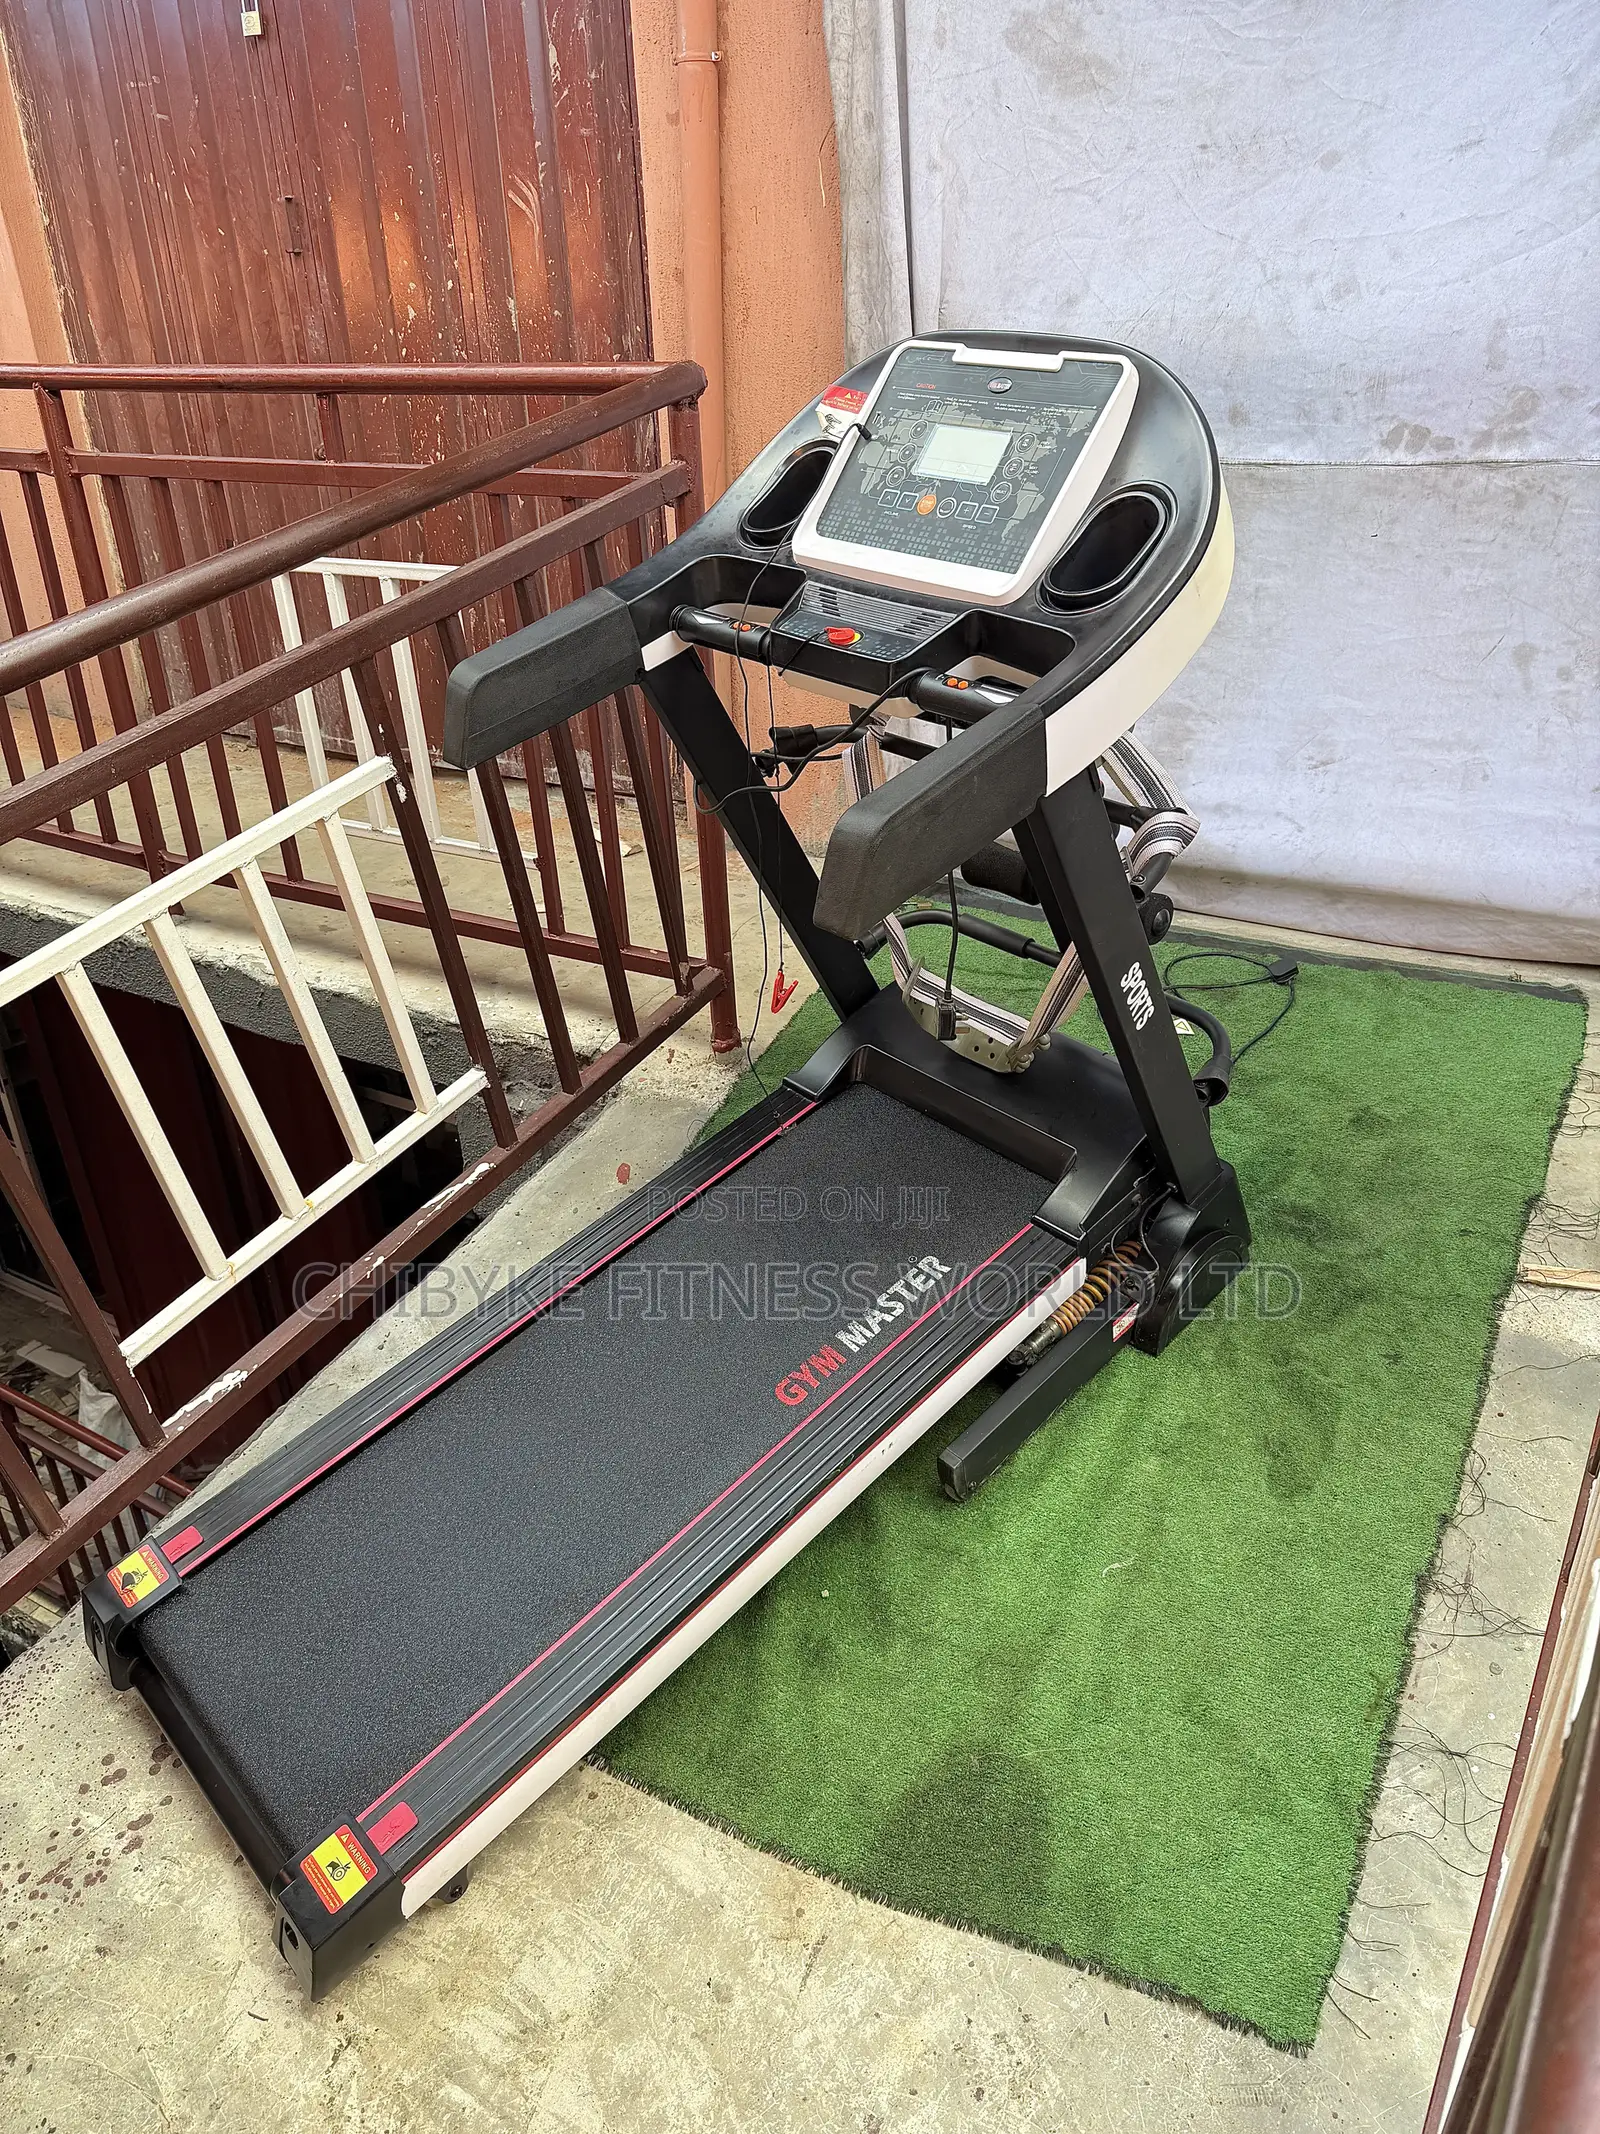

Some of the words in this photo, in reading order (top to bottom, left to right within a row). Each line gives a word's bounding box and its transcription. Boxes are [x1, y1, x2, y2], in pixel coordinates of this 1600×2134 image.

[1120, 961, 1155, 1031] SPORTS
[775, 1344, 848, 1406] GYM
[834, 1254, 951, 1353] MASTER
[147, 1556, 164, 1579] WARNING
[347, 1841, 371, 1874] WARNING
